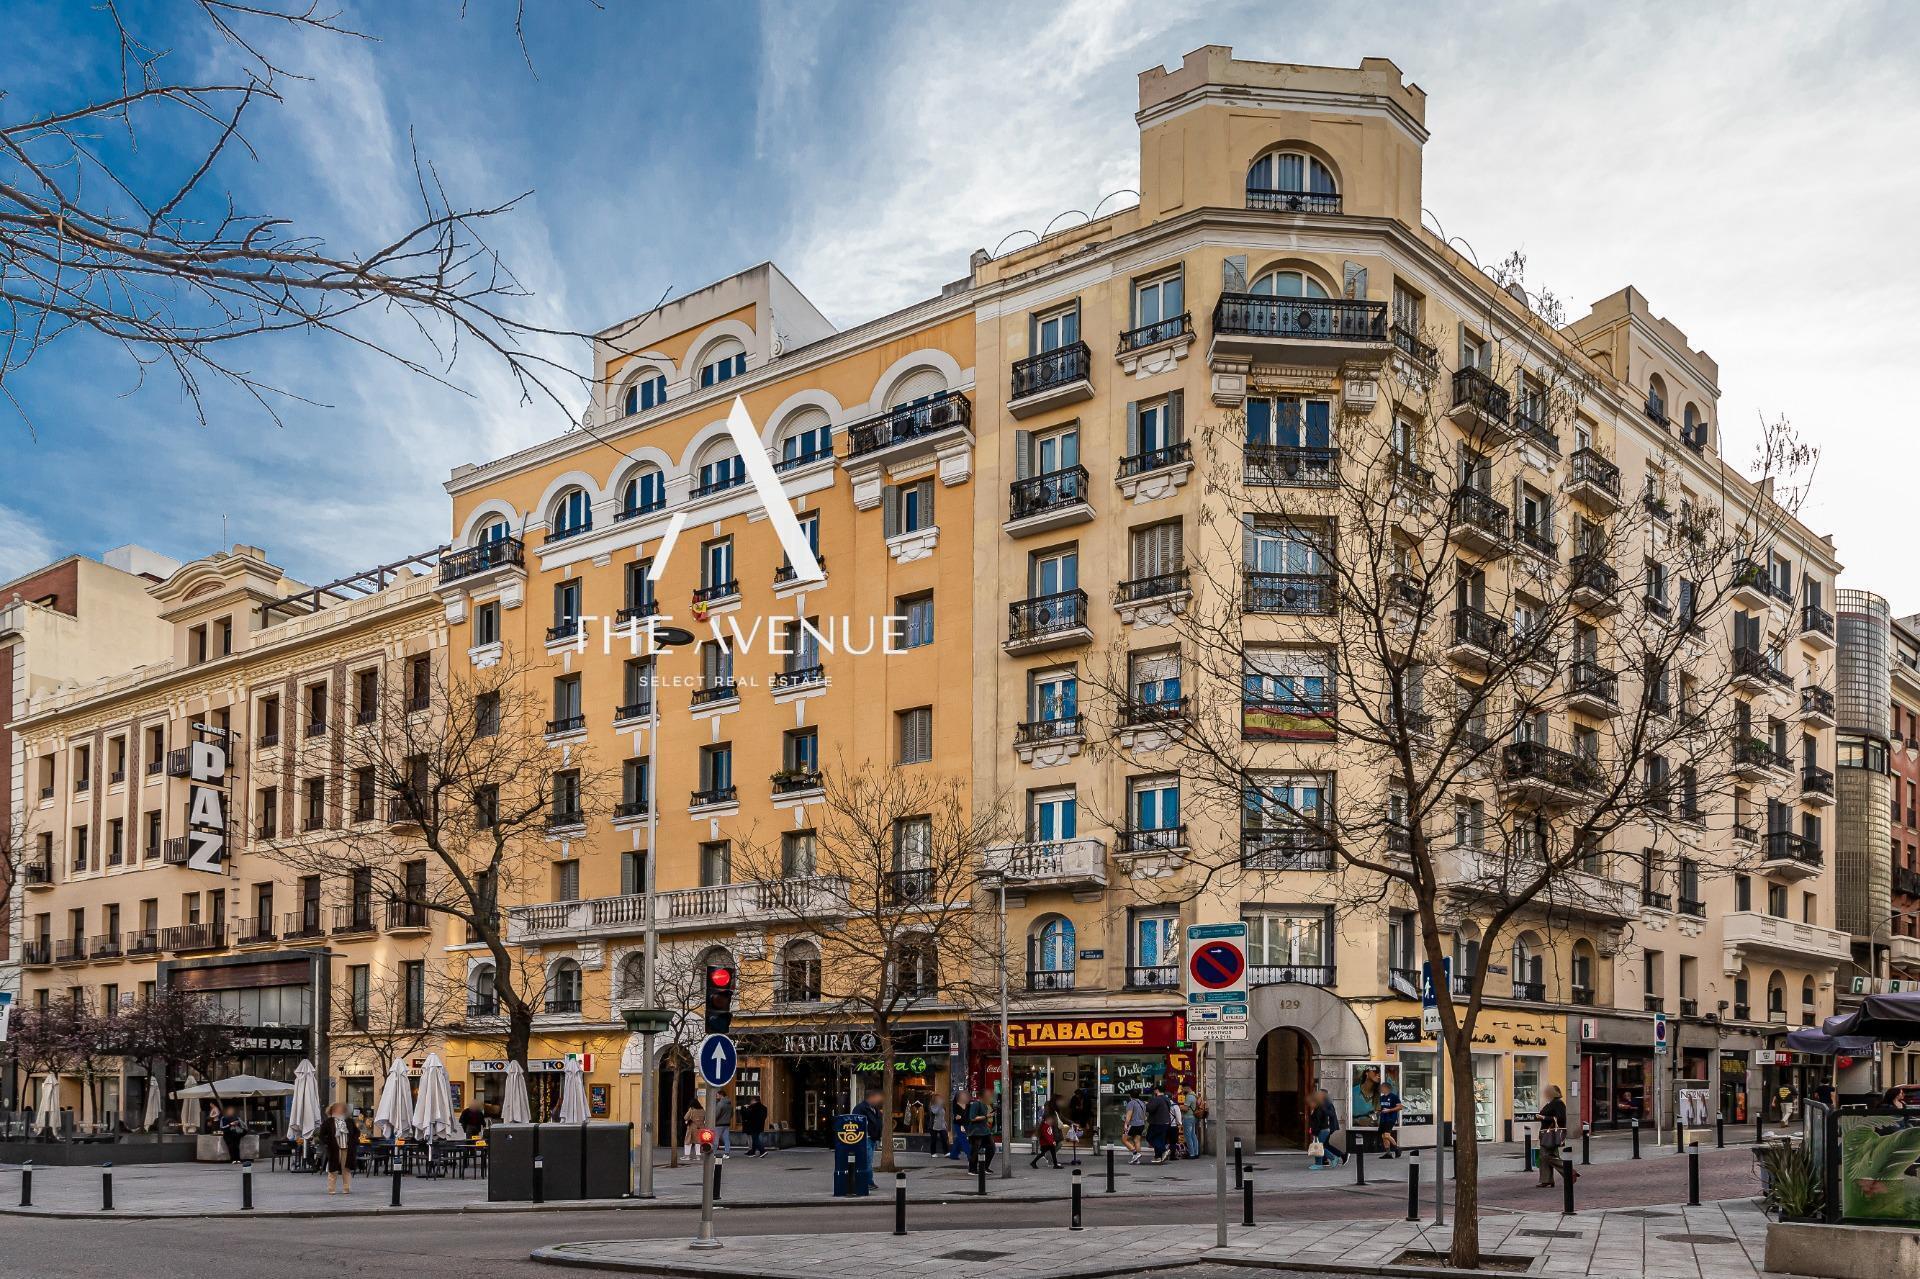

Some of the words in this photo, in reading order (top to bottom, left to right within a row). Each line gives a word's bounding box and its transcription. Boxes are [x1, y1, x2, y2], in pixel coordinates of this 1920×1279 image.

[193, 722, 226, 736] CINE
[188, 740, 226, 873] PAZ
[1280, 1000, 1300, 1009] 129
[1027, 1021, 1144, 1040] TABACOS
[270, 1039, 302, 1050] PAZ
[785, 1034, 852, 1052] NATURA
[928, 1034, 944, 1045] 127
[484, 1061, 504, 1070] TKO
[542, 1061, 564, 1070] TKO
[855, 1060, 909, 1071] nata
